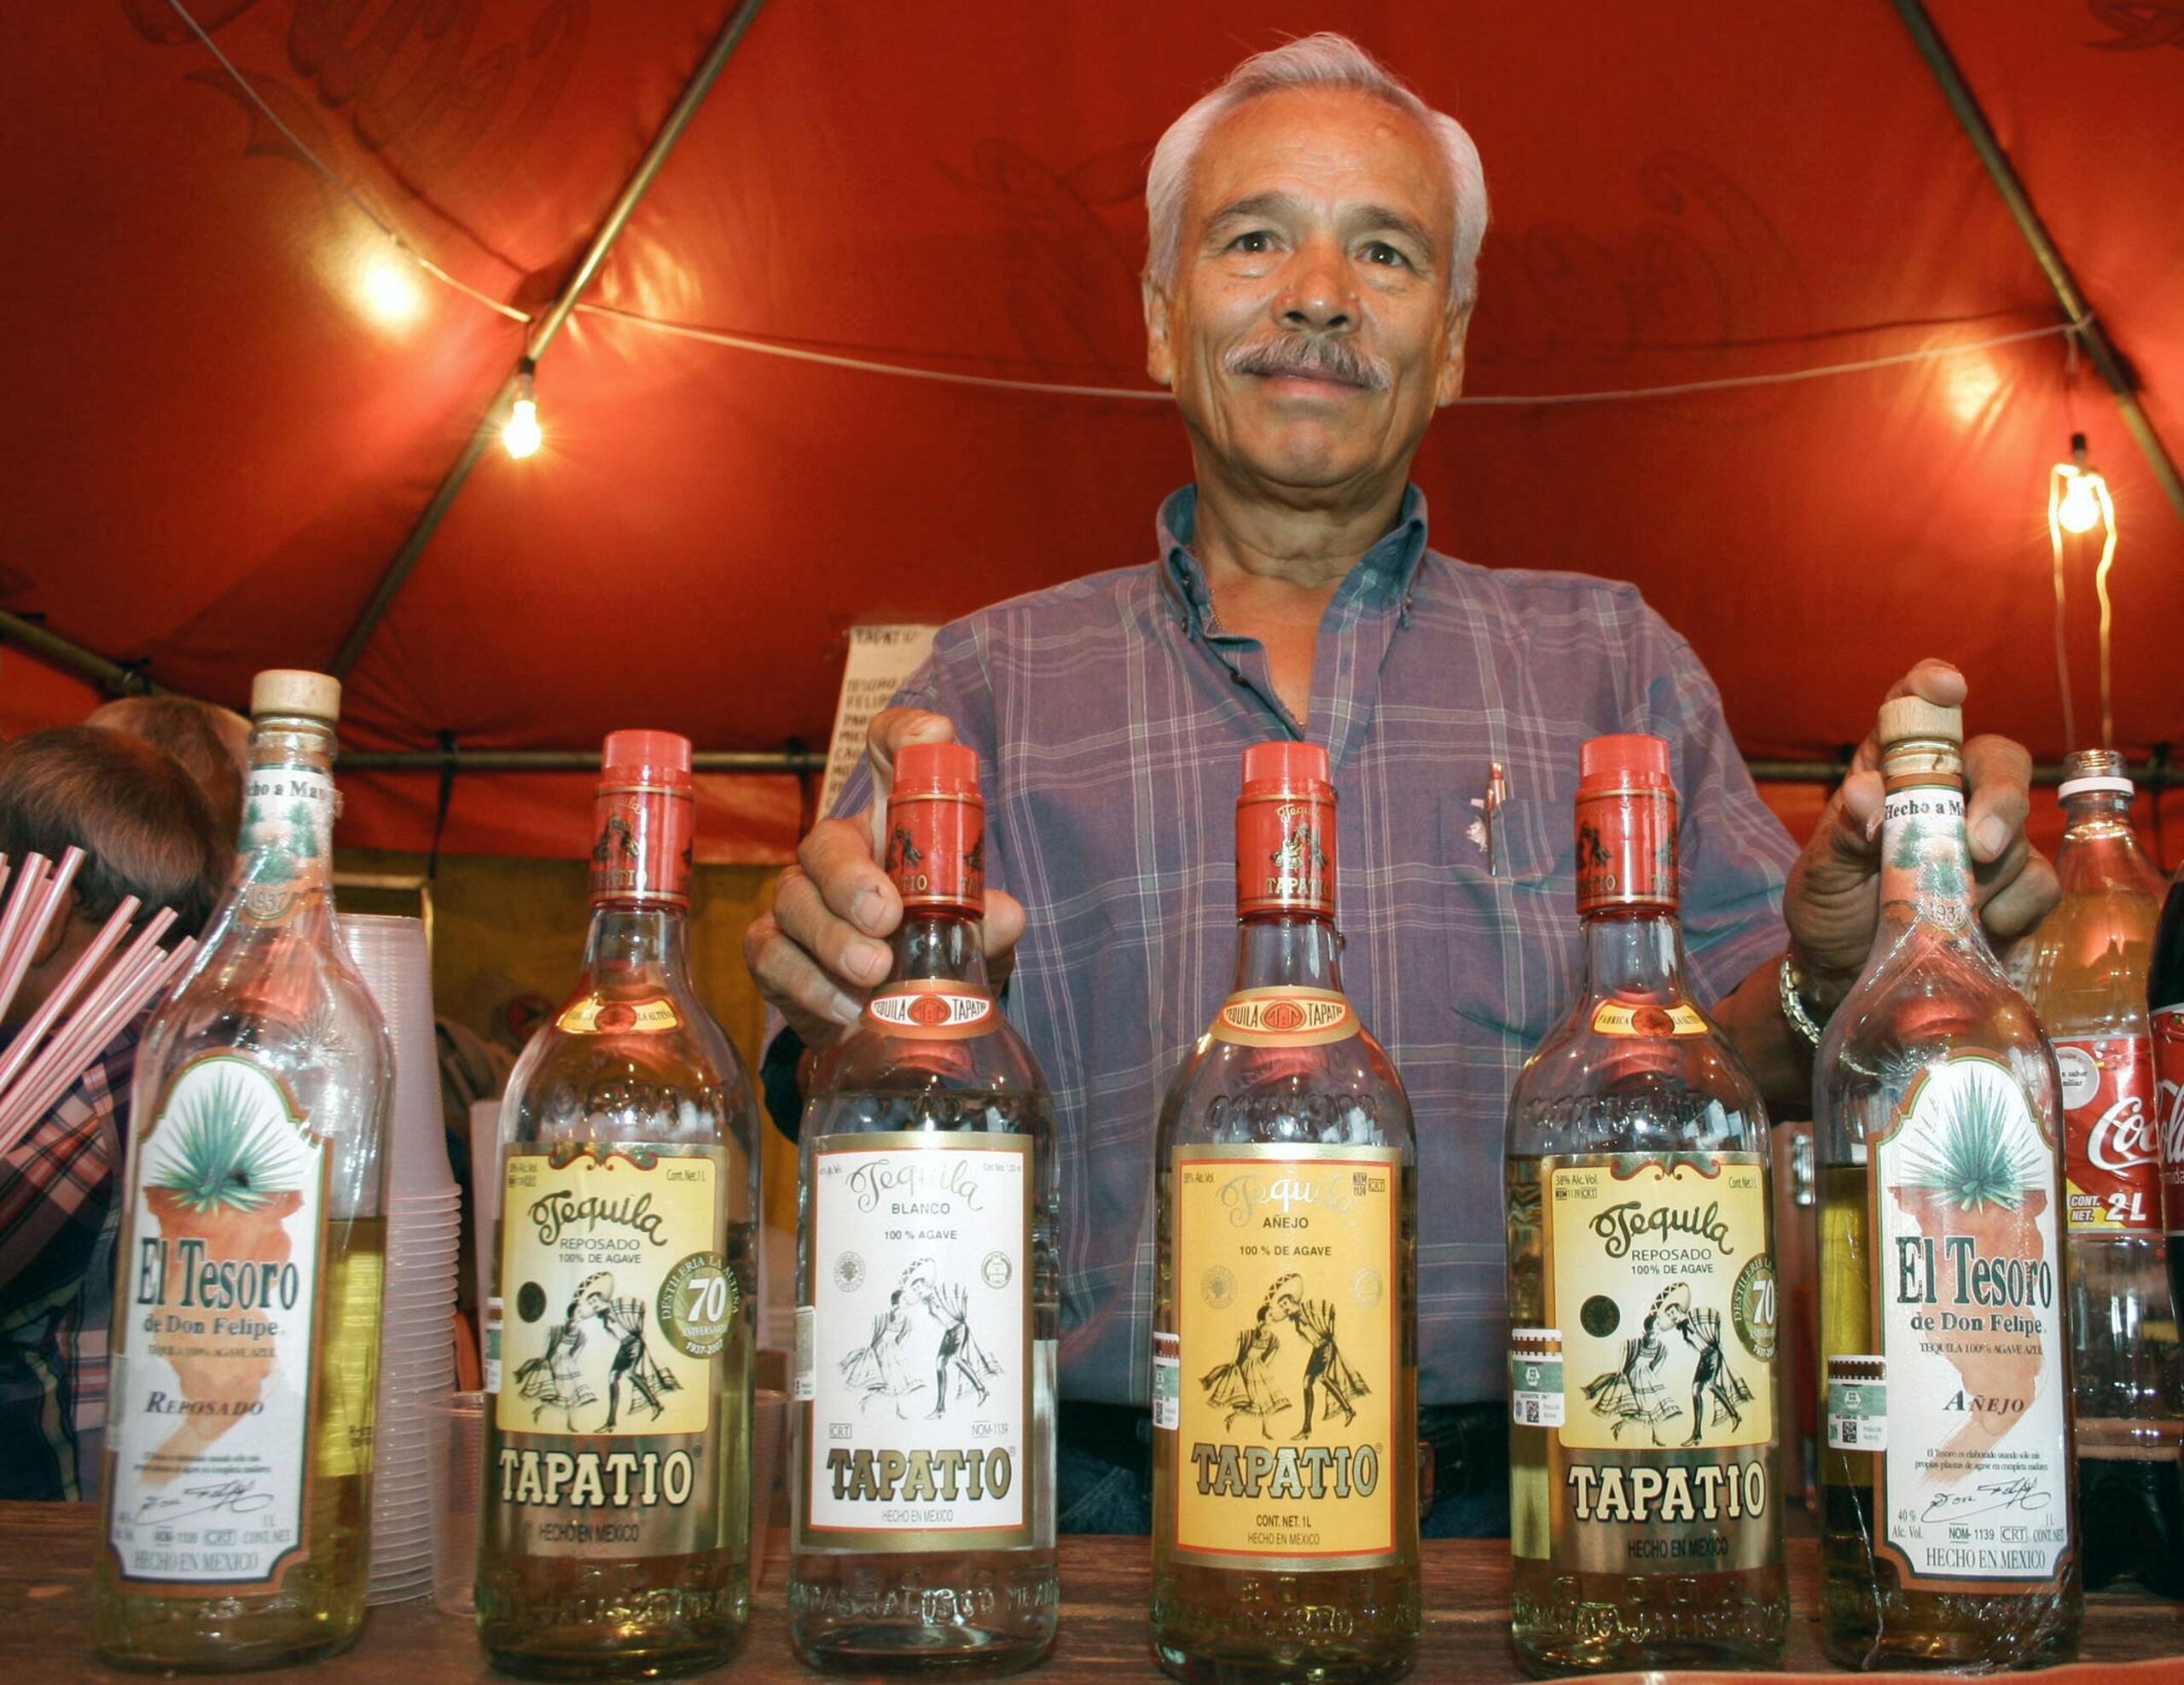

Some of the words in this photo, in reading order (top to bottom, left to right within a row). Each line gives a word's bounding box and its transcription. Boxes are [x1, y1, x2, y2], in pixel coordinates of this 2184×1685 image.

[1885, 799, 1930, 820] Hecho
[1936, 804, 1945, 814] a
[874, 999, 907, 1021] TEQUILA
[1226, 1004, 1258, 1027] TEQUILA
[891, 1202, 951, 1216] BLANCO
[2070, 1195, 2101, 1208] CONT.
[527, 1189, 668, 1246] Tequila
[1262, 1213, 1310, 1229] AÑEJO
[2071, 1208, 2095, 1222] NET.
[884, 1229, 903, 1241] 100
[904, 1230, 915, 1241] %
[917, 1229, 958, 1241] AGAVE
[1589, 1200, 1734, 1258] Tequila
[559, 1238, 641, 1251] REPOSADO
[1239, 1246, 1258, 1257] 100
[1260, 1246, 1271, 1257] %
[1274, 1246, 1290, 1257] DE
[1292, 1246, 1333, 1257] AGAVE
[1631, 1248, 1712, 1262] REPOSADO
[558, 1252, 584, 1264] 100%
[587, 1252, 603, 1264] DE
[605, 1252, 642, 1264] AGAVE
[136, 1237, 168, 1306] El
[177, 1239, 299, 1311] Tesoro
[1630, 1264, 1660, 1275] 100%
[1663, 1264, 1678, 1275] DE
[1680, 1264, 1714, 1275] AGAVE
[1895, 1236, 1937, 1304] El
[1944, 1236, 2053, 1310] Tesoro
[687, 1276, 727, 1323] 70
[1752, 1278, 1774, 1325] 70
[142, 1314, 161, 1333] de
[165, 1314, 206, 1334] Don
[212, 1316, 279, 1341] Felipe
[1909, 1311, 1935, 1331] de
[1940, 1312, 1984, 1331] Don
[1989, 1314, 2042, 1339] Felipe
[1920, 1342, 1962, 1355] TEQUILA
[1992, 1344, 2023, 1355] AGAVE
[144, 1391, 264, 1416] REPOSADO
[1942, 1389, 2025, 1415] AÑEJO
[831, 1425, 851, 1438] CRT
[499, 1448, 694, 1507] TAPATIO
[826, 1446, 1013, 1502] TAPATIO
[1190, 1443, 1380, 1500] TAPATIO
[1567, 1460, 1767, 1523] TAPATIO
[881, 1509, 909, 1522] HECHO
[910, 1509, 922, 1522] EN
[923, 1509, 954, 1523] MEXICO
[1256, 1514, 1280, 1527] CONT.
[1282, 1514, 1301, 1528] NET.
[1302, 1515, 1312, 1528] 1L
[1247, 1532, 1275, 1545] HECHO
[1276, 1532, 1288, 1545] EN
[1288, 1533, 1321, 1546] MEXICO
[1973, 1529, 1995, 1541] 1139
[2001, 1527, 2025, 1541] CRT
[1627, 1539, 1667, 1559] HECHO
[1670, 1538, 1687, 1558] EN
[1687, 1537, 1729, 1557] MEXICO
[1926, 1547, 1977, 1568] HECHO
[1978, 1548, 1998, 1569] EN
[2001, 1548, 2046, 1570] MEXICO
